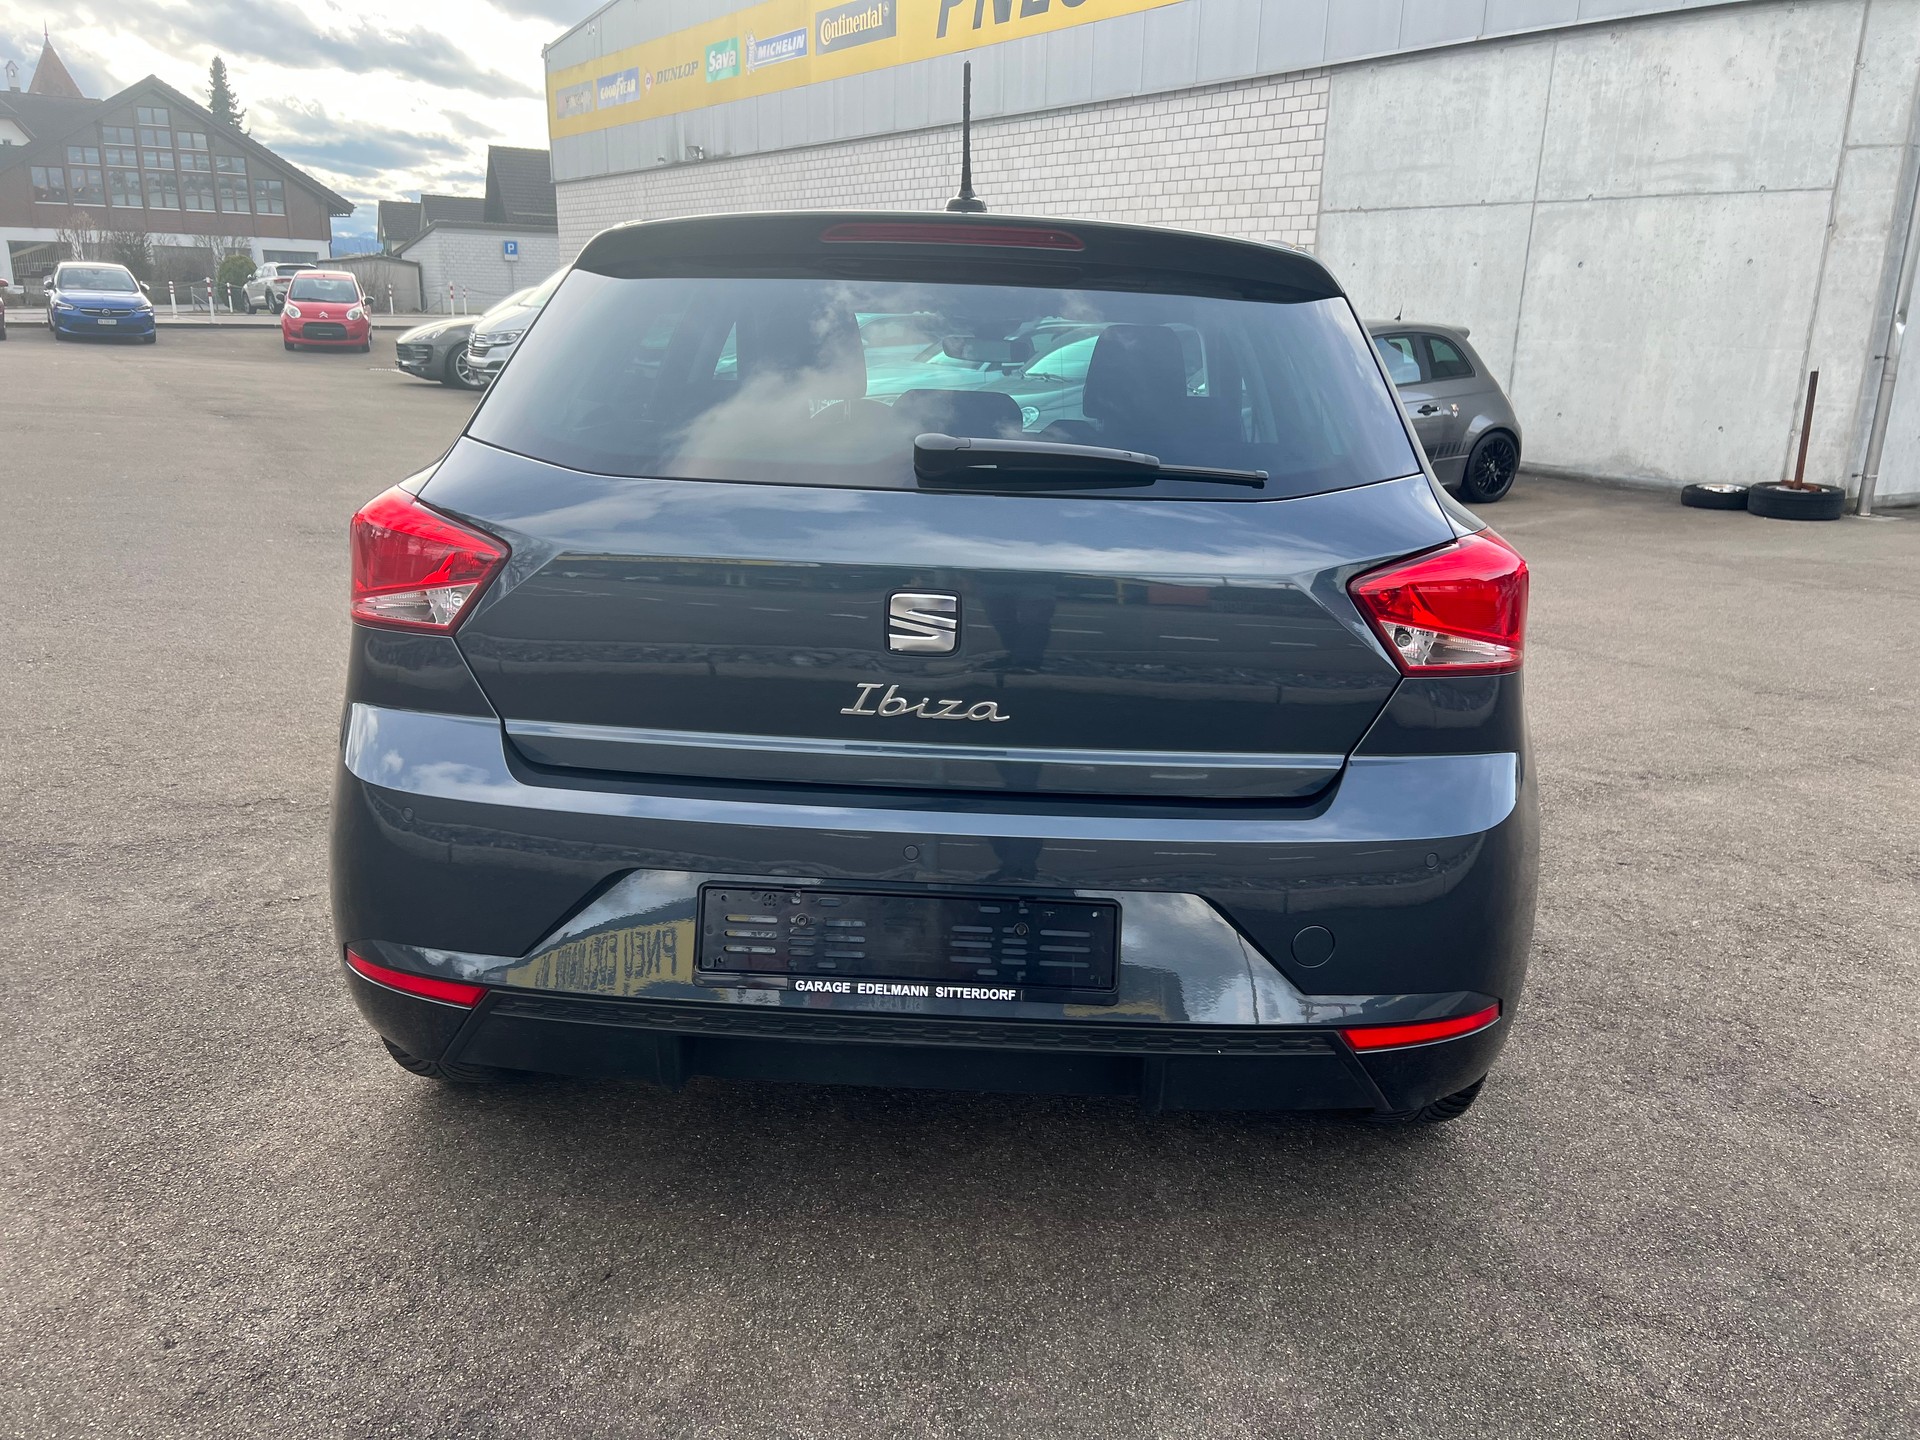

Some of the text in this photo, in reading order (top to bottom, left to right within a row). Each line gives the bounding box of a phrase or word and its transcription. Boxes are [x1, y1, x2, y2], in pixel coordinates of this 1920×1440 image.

[820, 7, 883, 45] Continental
[758, 34, 805, 59] MICHELIN
[655, 61, 699, 85] DUNLOP
[708, 50, 737, 73] Sava
[600, 77, 636, 100] GOODYEAR
[840, 683, 1010, 722] Ibiza
[795, 980, 1017, 1001] GARAGE EDELMANN SITTERDORF
